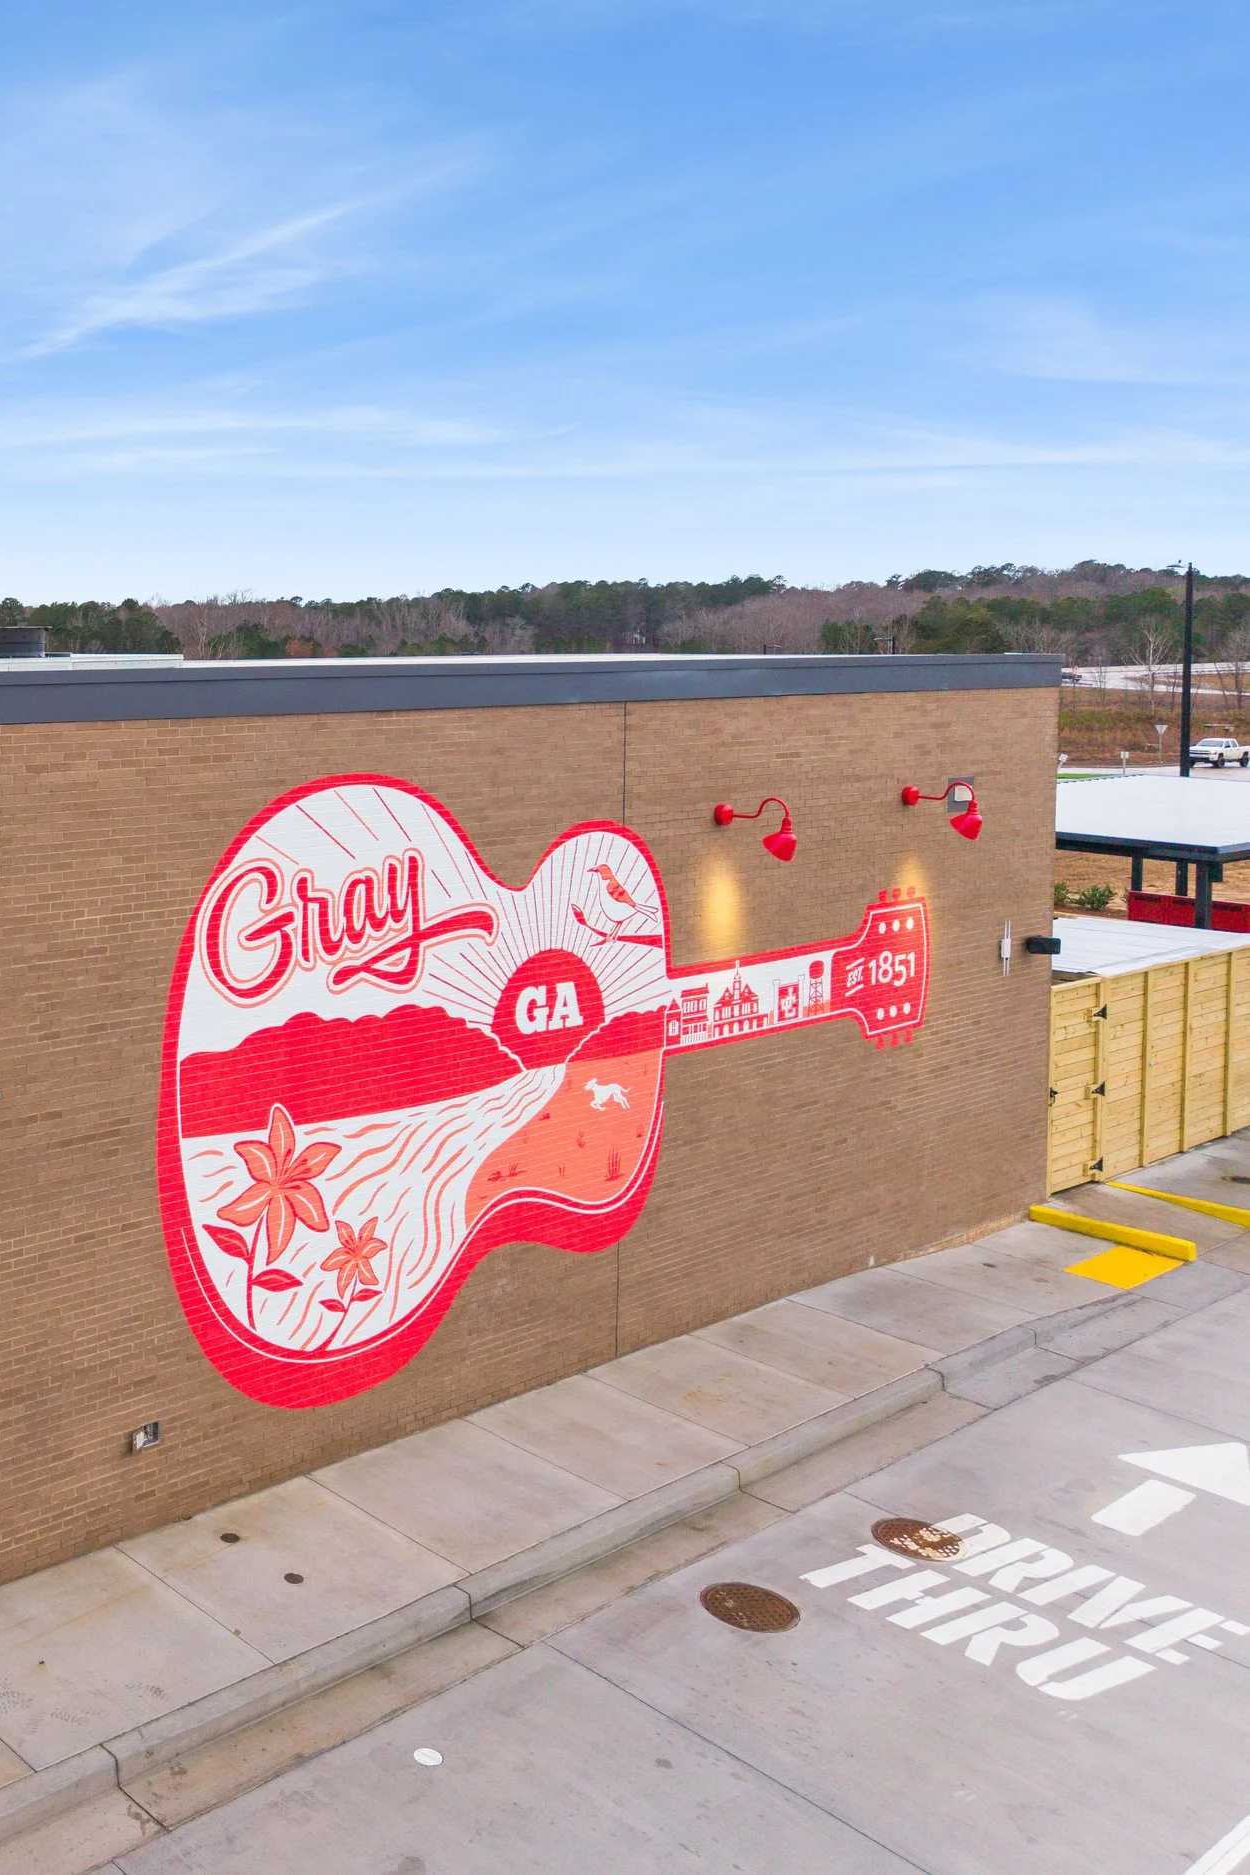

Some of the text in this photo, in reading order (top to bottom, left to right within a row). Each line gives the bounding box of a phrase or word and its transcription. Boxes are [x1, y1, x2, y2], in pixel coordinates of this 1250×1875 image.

[198, 847, 500, 1008] Gray
[868, 950, 915, 987] 1851
[515, 981, 584, 1034] GA
[798, 1543, 1157, 1700] THRU
[890, 1512, 1250, 1665] DRIVE
